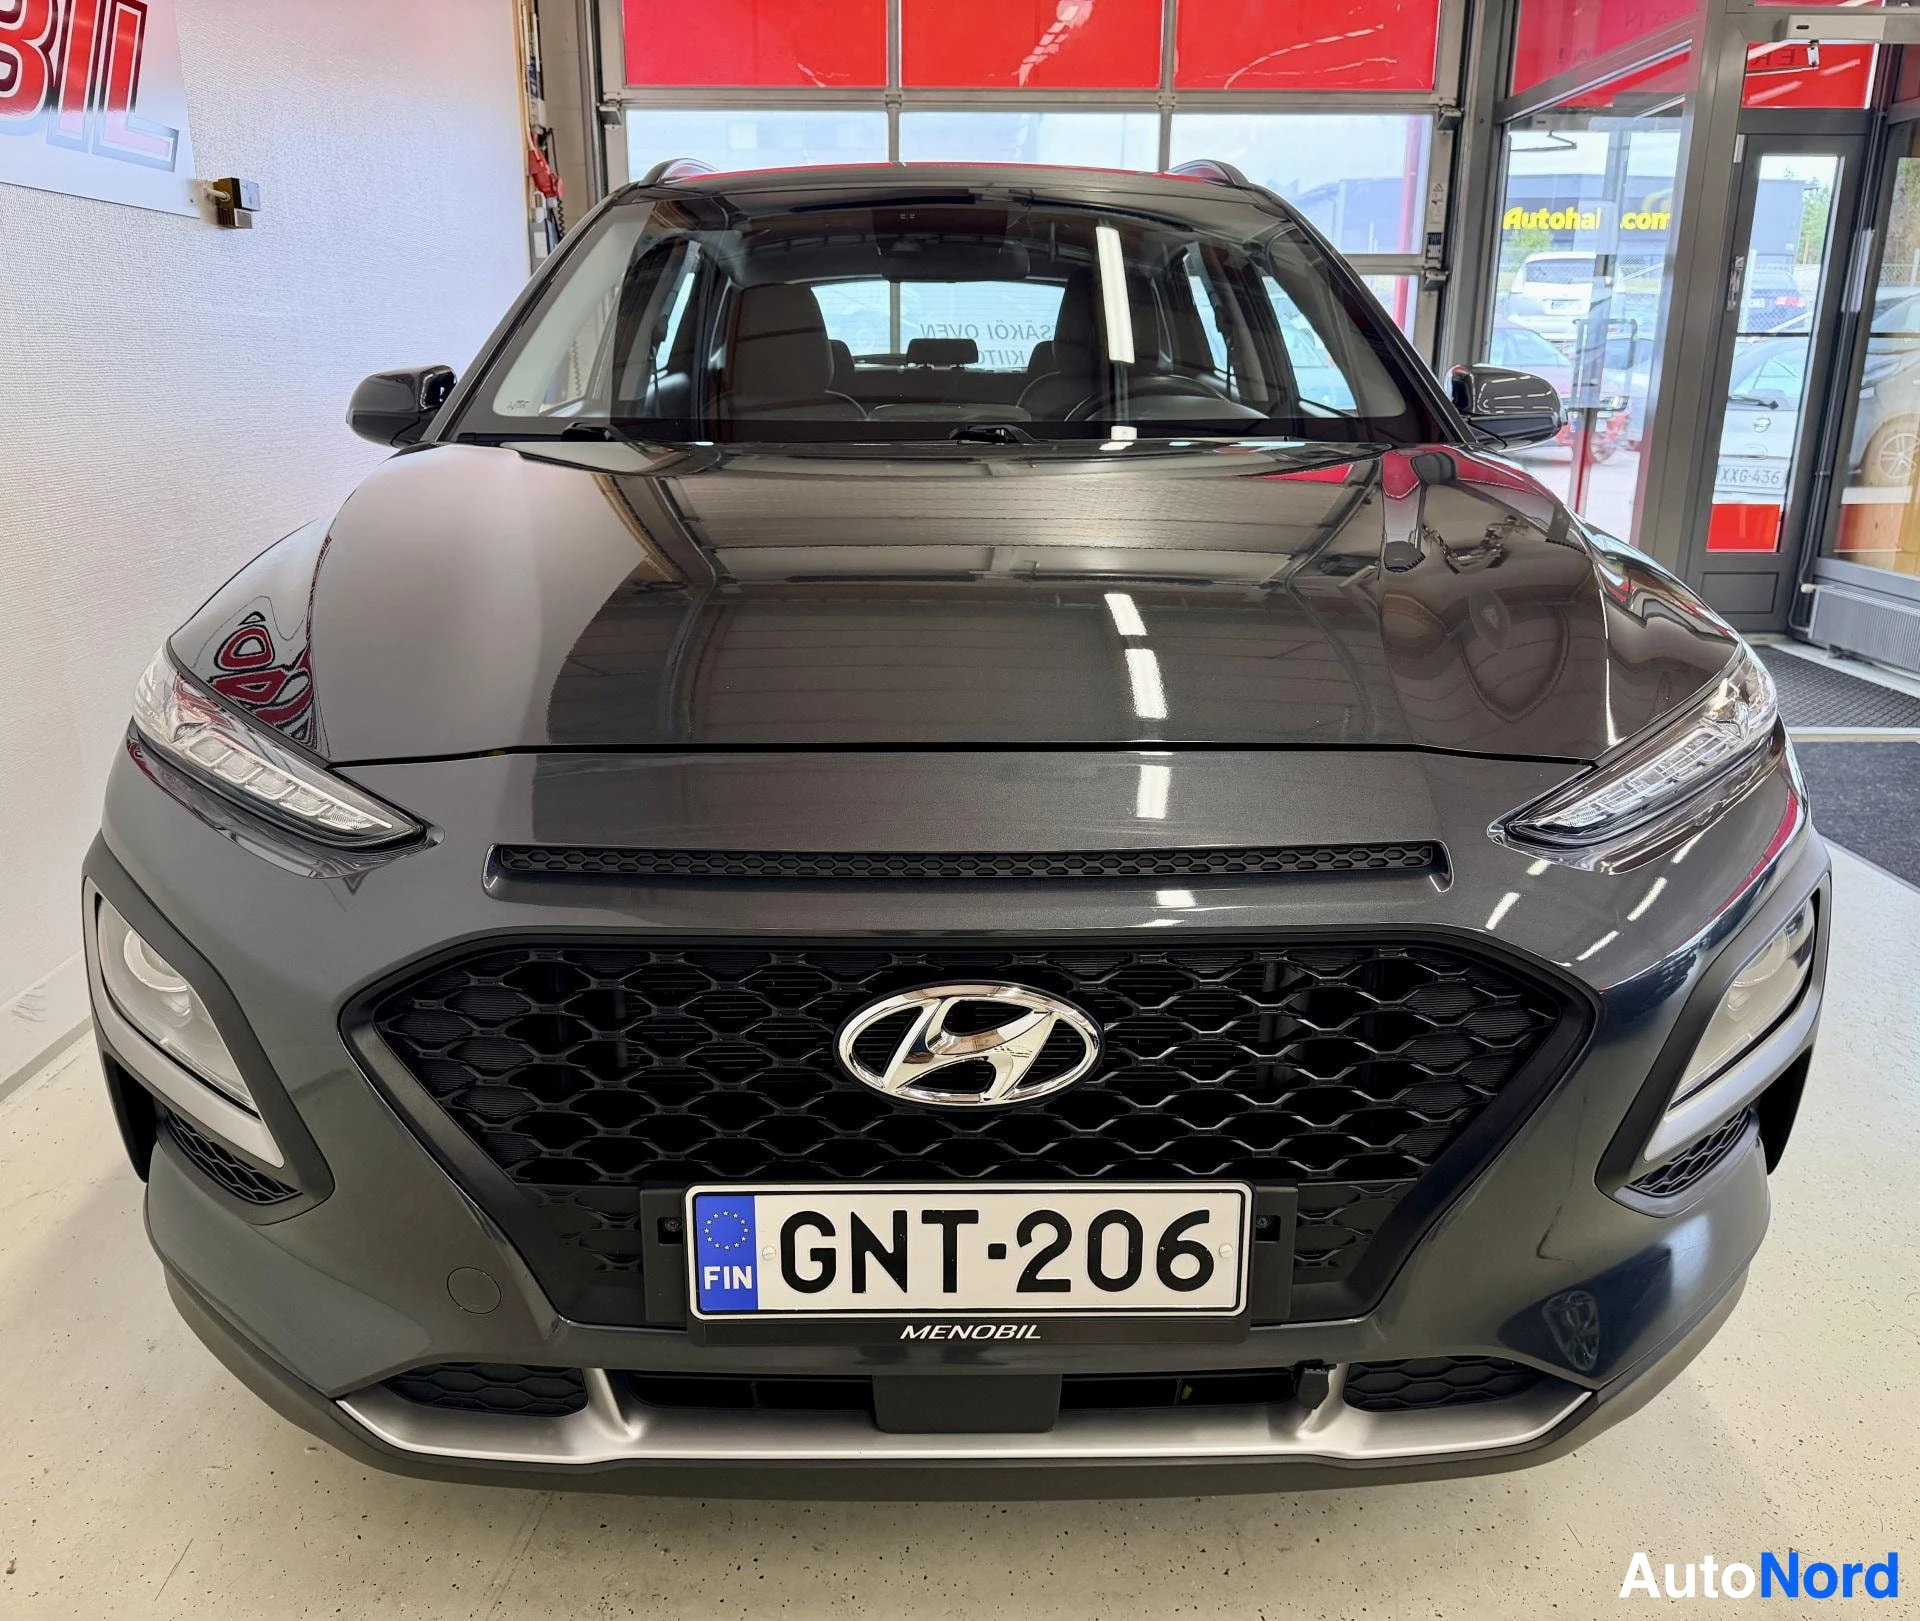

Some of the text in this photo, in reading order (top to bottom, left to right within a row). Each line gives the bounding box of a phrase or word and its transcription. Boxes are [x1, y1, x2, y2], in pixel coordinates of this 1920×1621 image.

[780, 1209, 1215, 1294] GNT-206
[704, 1265, 753, 1290] FIN
[899, 1324, 1042, 1341] MENOBIL
